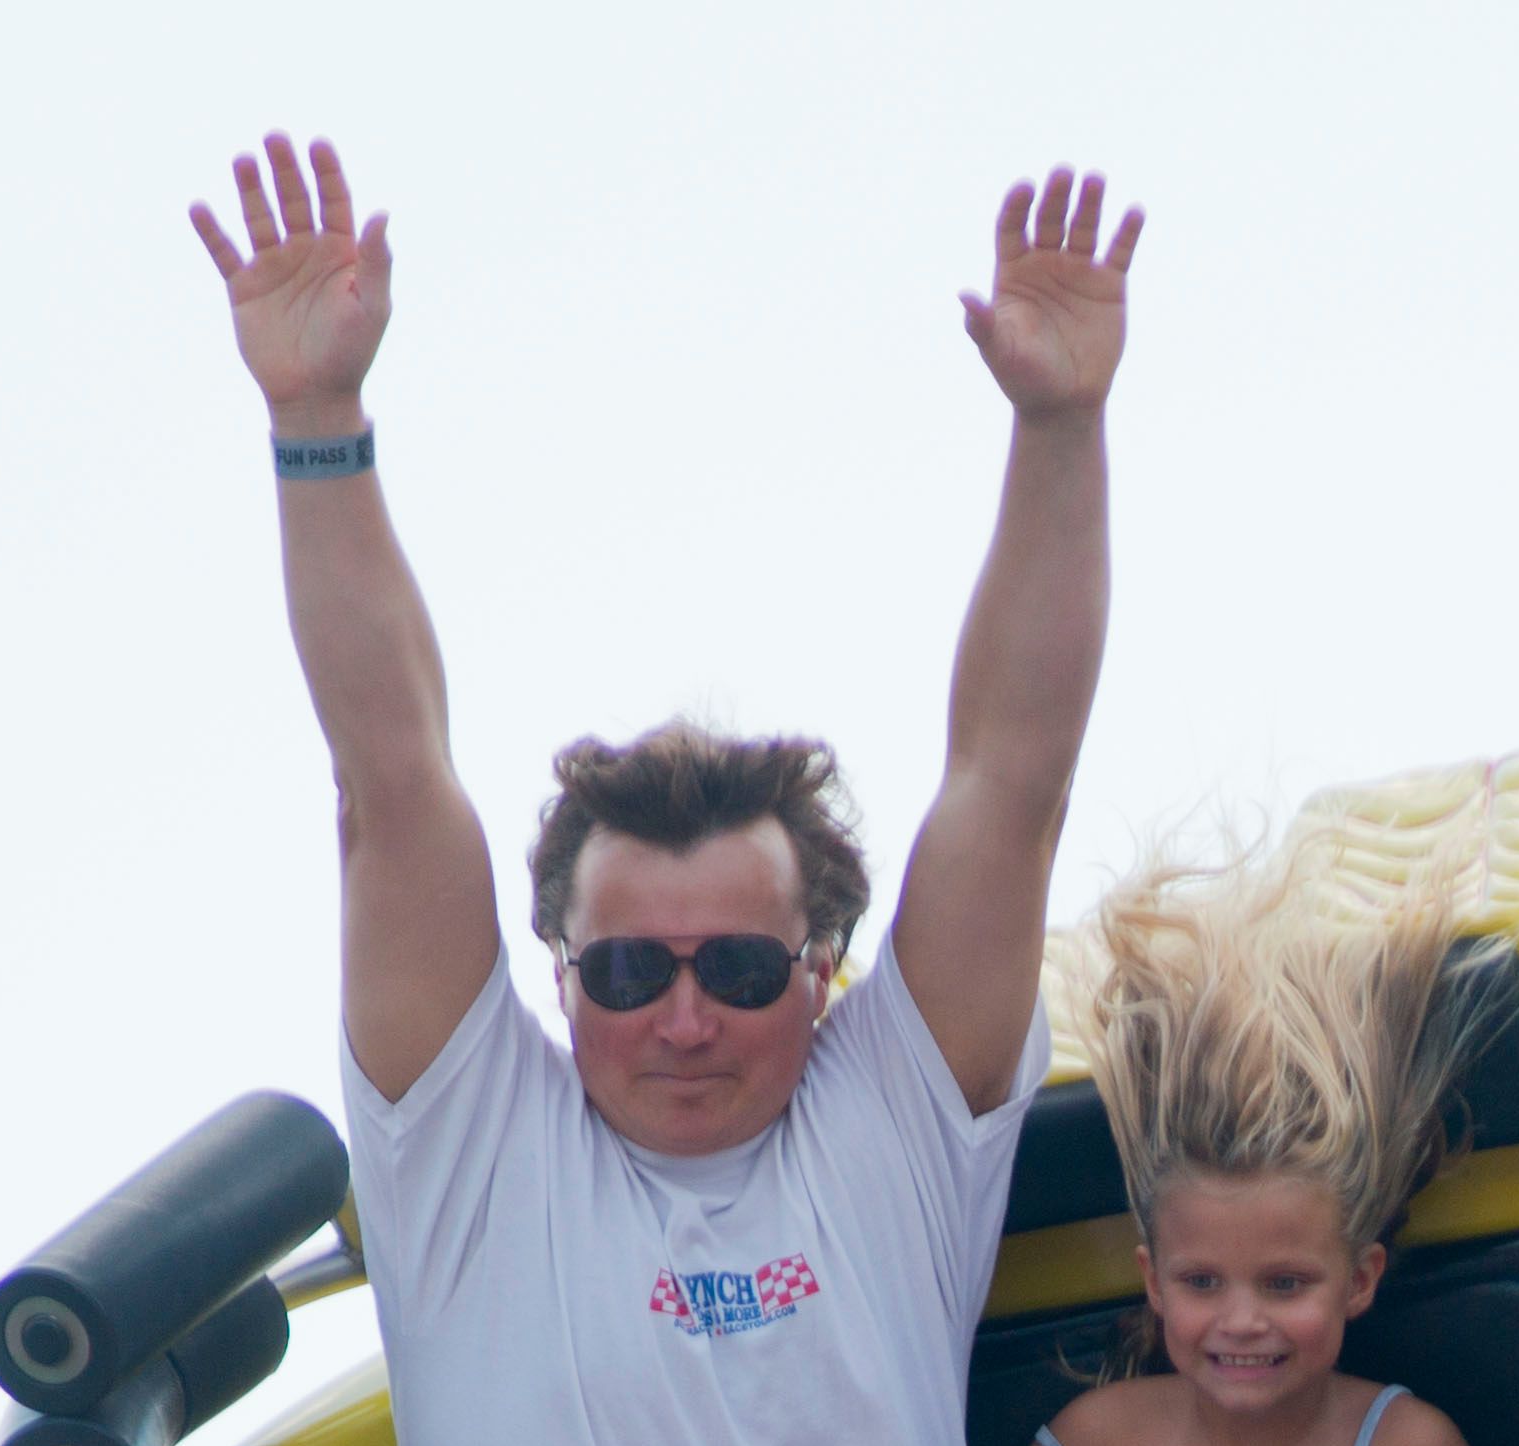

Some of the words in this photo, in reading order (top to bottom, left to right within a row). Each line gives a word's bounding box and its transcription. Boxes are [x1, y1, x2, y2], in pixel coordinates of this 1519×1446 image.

[275, 447, 304, 466] FUN
[308, 446, 347, 466] PASS
[678, 1270, 758, 1308] YNCH
[723, 1304, 762, 1322] MORE
